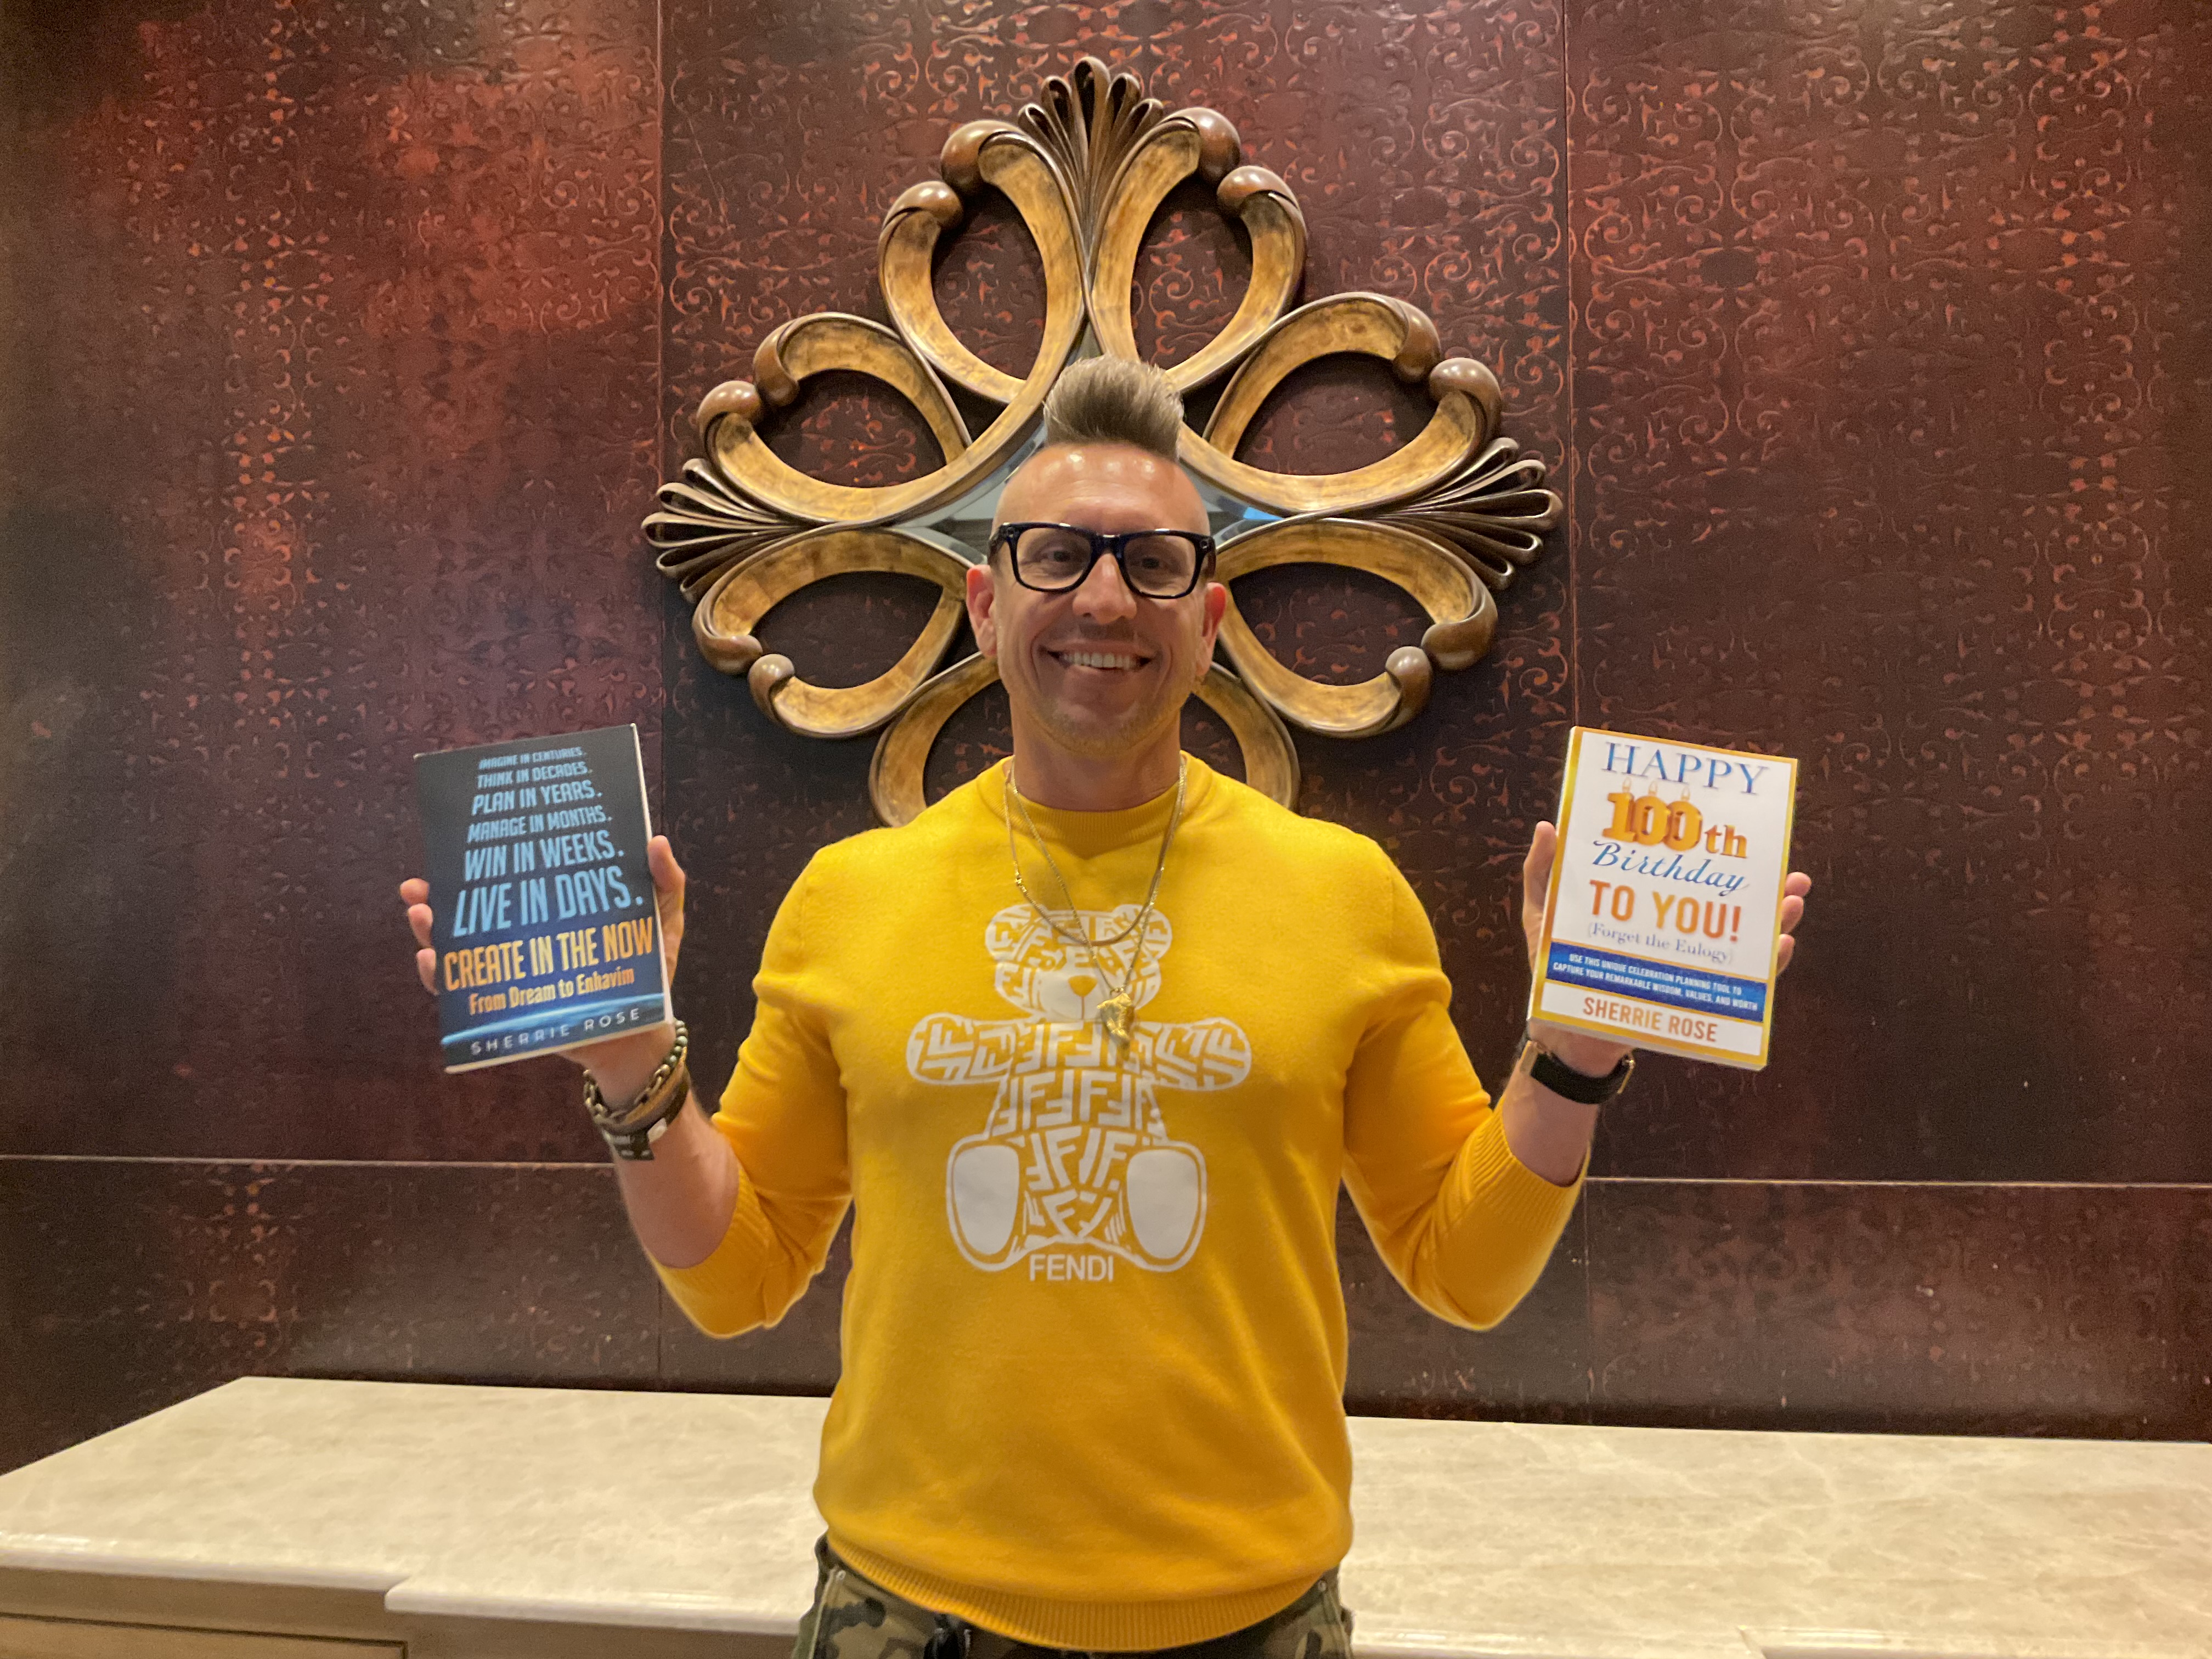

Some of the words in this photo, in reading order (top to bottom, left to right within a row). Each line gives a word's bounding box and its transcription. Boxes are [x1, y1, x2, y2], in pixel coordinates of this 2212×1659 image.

[477, 771, 514, 789] THINK
[516, 769, 529, 783] IN
[478, 755, 518, 770] IMAGINE
[520, 753, 530, 764] IN
[1602, 742, 1770, 796] HAPPY
[471, 790, 515, 816] PLAN
[520, 787, 537, 809] IN
[540, 780, 602, 805] YEARS.
[467, 816, 526, 843] MANAGE
[529, 814, 545, 833] IN
[546, 805, 613, 831] MONTHS.
[1602, 790, 1748, 859] 100th
[464, 845, 506, 882] WIN
[515, 841, 535, 873] IN
[540, 830, 624, 869] WEEKS.
[1593, 840, 1749, 897] Birthday
[453, 882, 512, 938] LIVE
[520, 876, 549, 926] IN
[556, 865, 643, 920] DAYS.
[1589, 879, 1634, 922] TO
[1651, 890, 1741, 943] YOU!
[444, 940, 526, 991] CREATE
[531, 935, 553, 975] IN
[556, 927, 599, 969] THE
[602, 916, 654, 963] NOW
[1588, 922, 1640, 944] (Forget
[1646, 934, 1670, 949] the
[1675, 939, 1733, 964] Eulogy)
[469, 992, 507, 1015] From
[509, 980, 556, 1008] Dream
[559, 979, 575, 998] to
[575, 966, 635, 994] Enhavim
[1553, 962, 1584, 975] CAPTURE
[1585, 968, 1604, 979] YOUR
[1605, 973, 1651, 990] REMARKABLE
[1714, 995, 1731, 1006] AND
[1569, 953, 1583, 963] USE
[1584, 956, 1600, 967] THIS
[1628, 966, 1674, 982] CELEBRATION
[1732, 986, 1742, 995] TO
[471, 1025, 571, 1056] SHERRIE
[584, 1008, 641, 1032] ROSE
[1583, 997, 1664, 1031] SHERRIE
[1668, 1015, 1718, 1042] ROSE
[1029, 1255, 1114, 1282] FENDI
